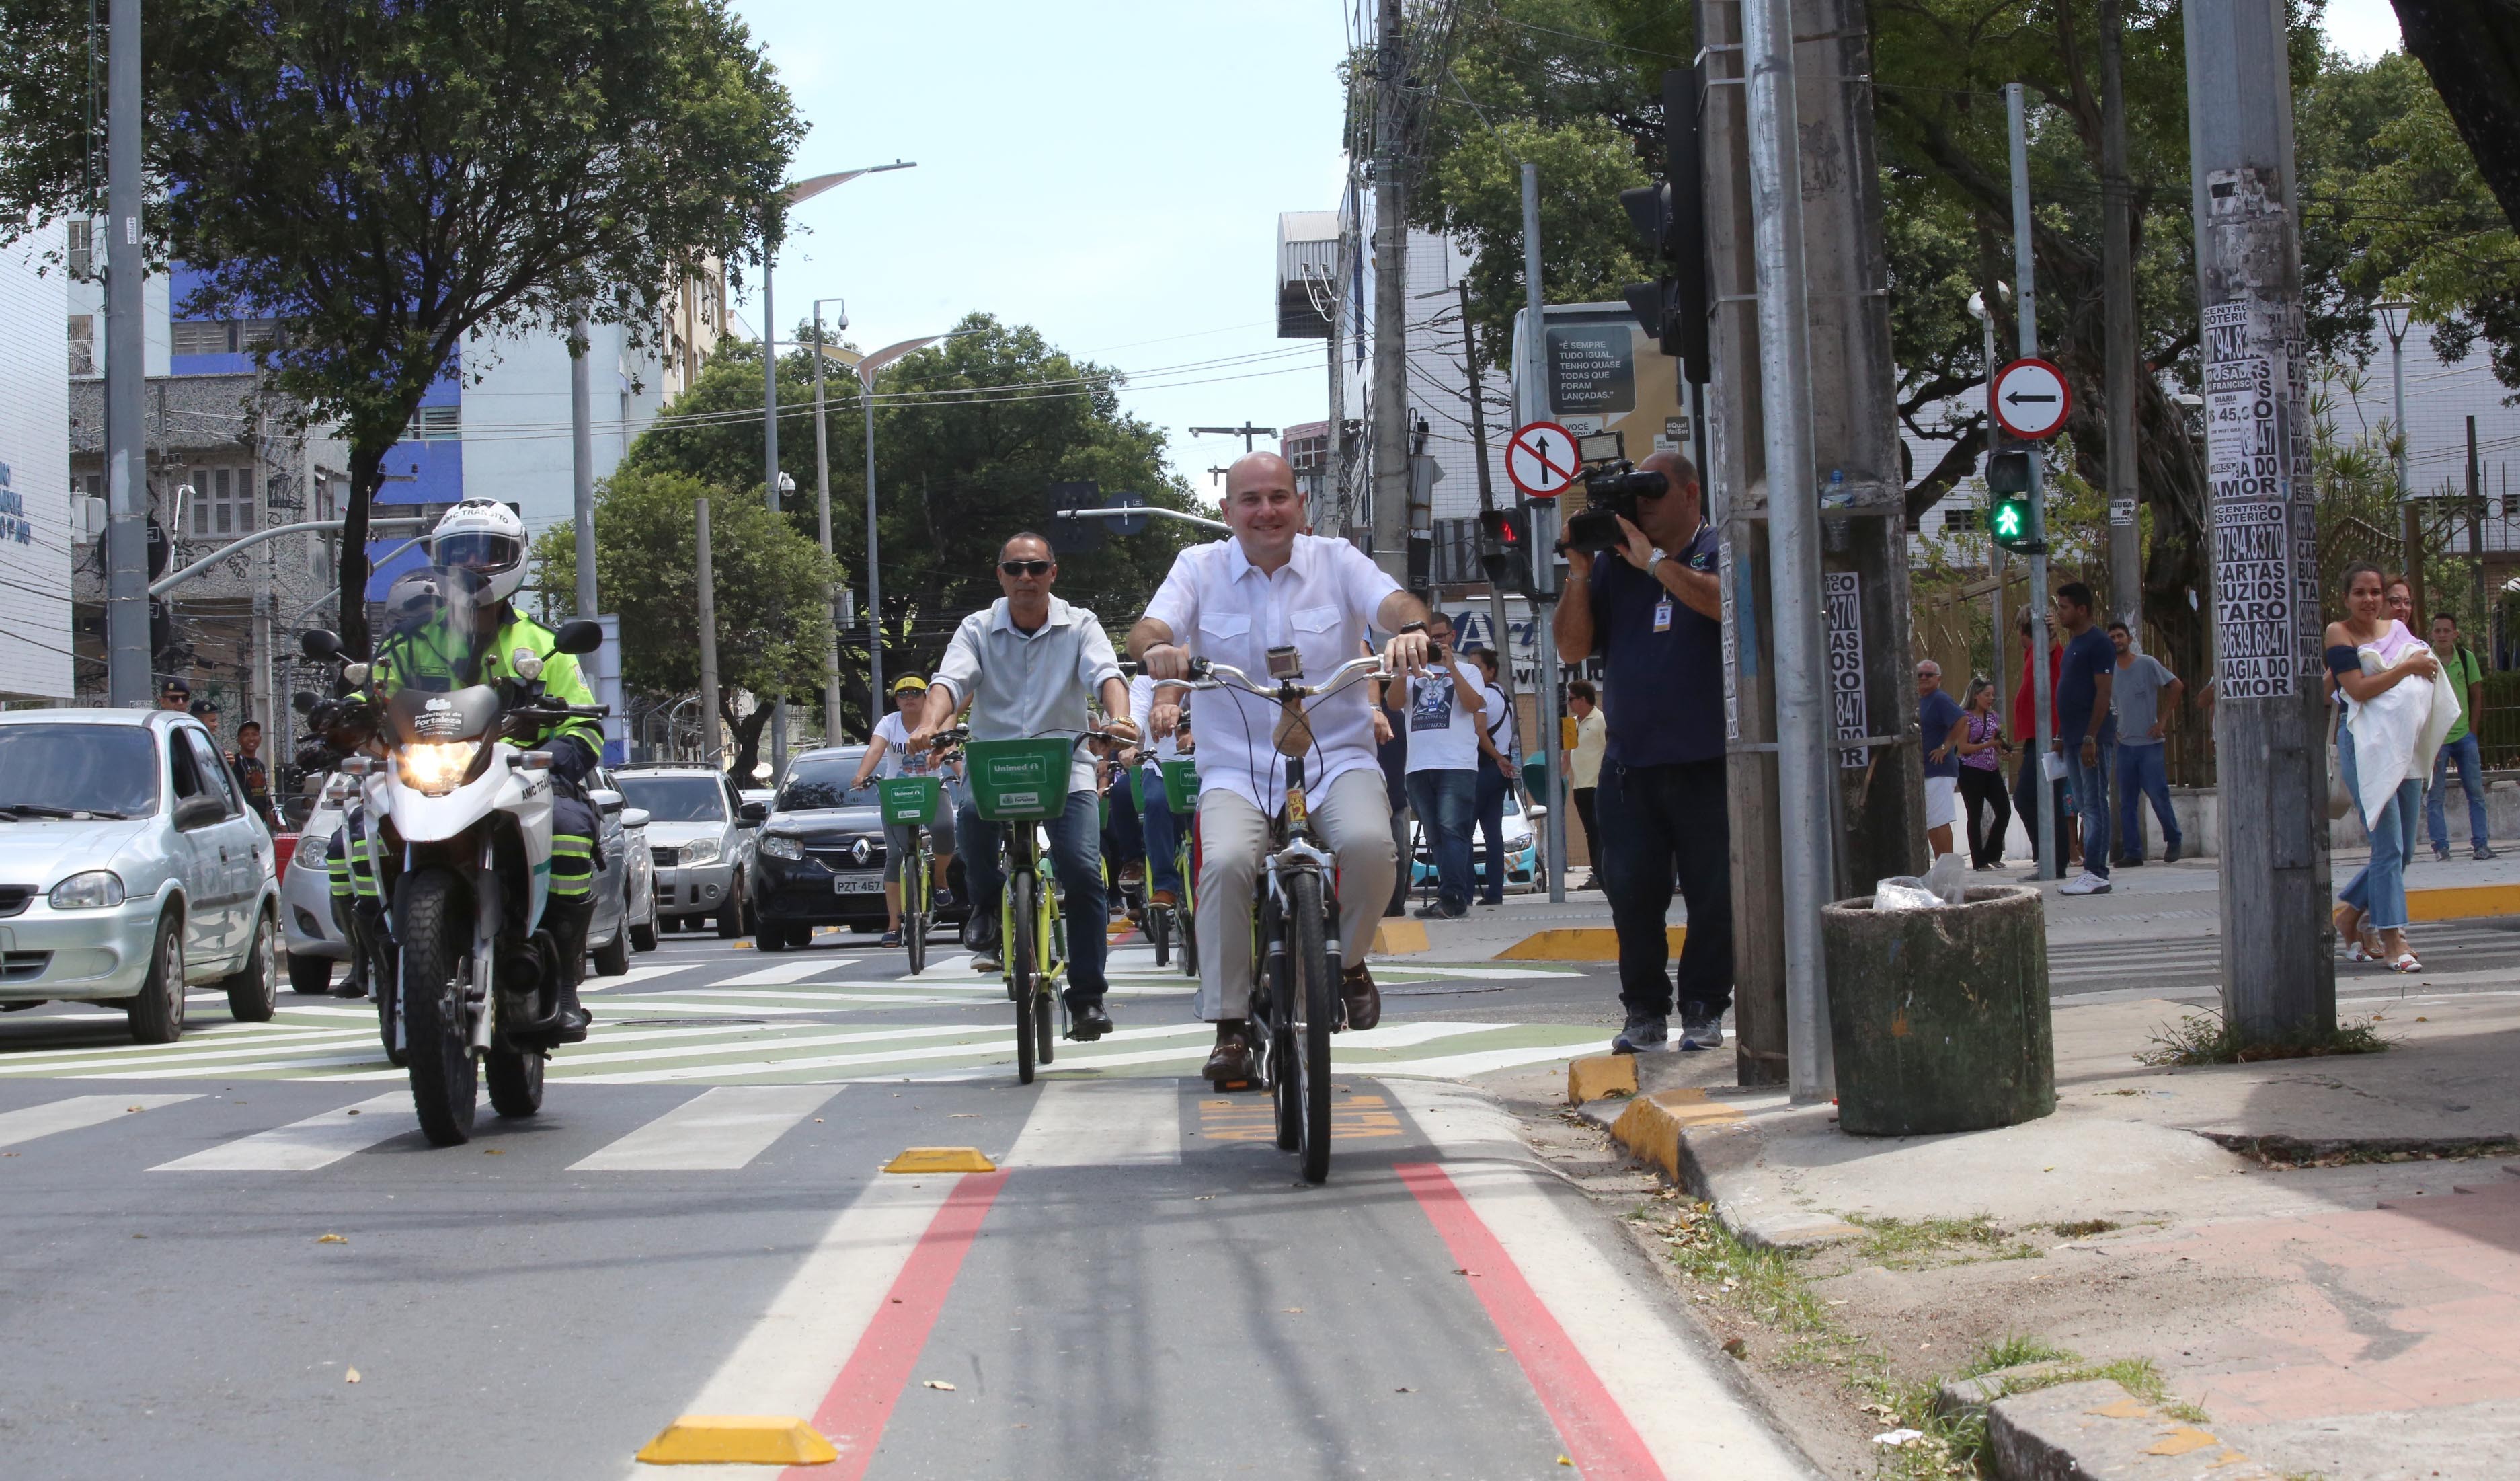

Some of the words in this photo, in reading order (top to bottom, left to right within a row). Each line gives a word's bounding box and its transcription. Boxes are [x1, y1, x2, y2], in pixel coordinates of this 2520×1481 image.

[1570, 341, 1606, 349] SEMPRE
[1560, 352, 1583, 360] TUDO
[1585, 351, 1614, 359] IGUAL,
[1560, 362, 1589, 370] TENHO
[1591, 360, 1621, 369] QUASE
[1561, 372, 1590, 380] TODAS
[1561, 382, 1592, 390] FORAM
[1565, 421, 1589, 430] VOCÊ
[2213, 477, 2278, 498] AMOR
[2217, 504, 2268, 515] CENTRO
[2267, 657, 2289, 678] DO
[2221, 678, 2289, 697] AMOR
[414, 712, 451, 720] Prefeitura
[414, 716, 462, 728] Fortaleza
[994, 763, 1027, 772] Unimed
[522, 784, 537, 801] AMC
